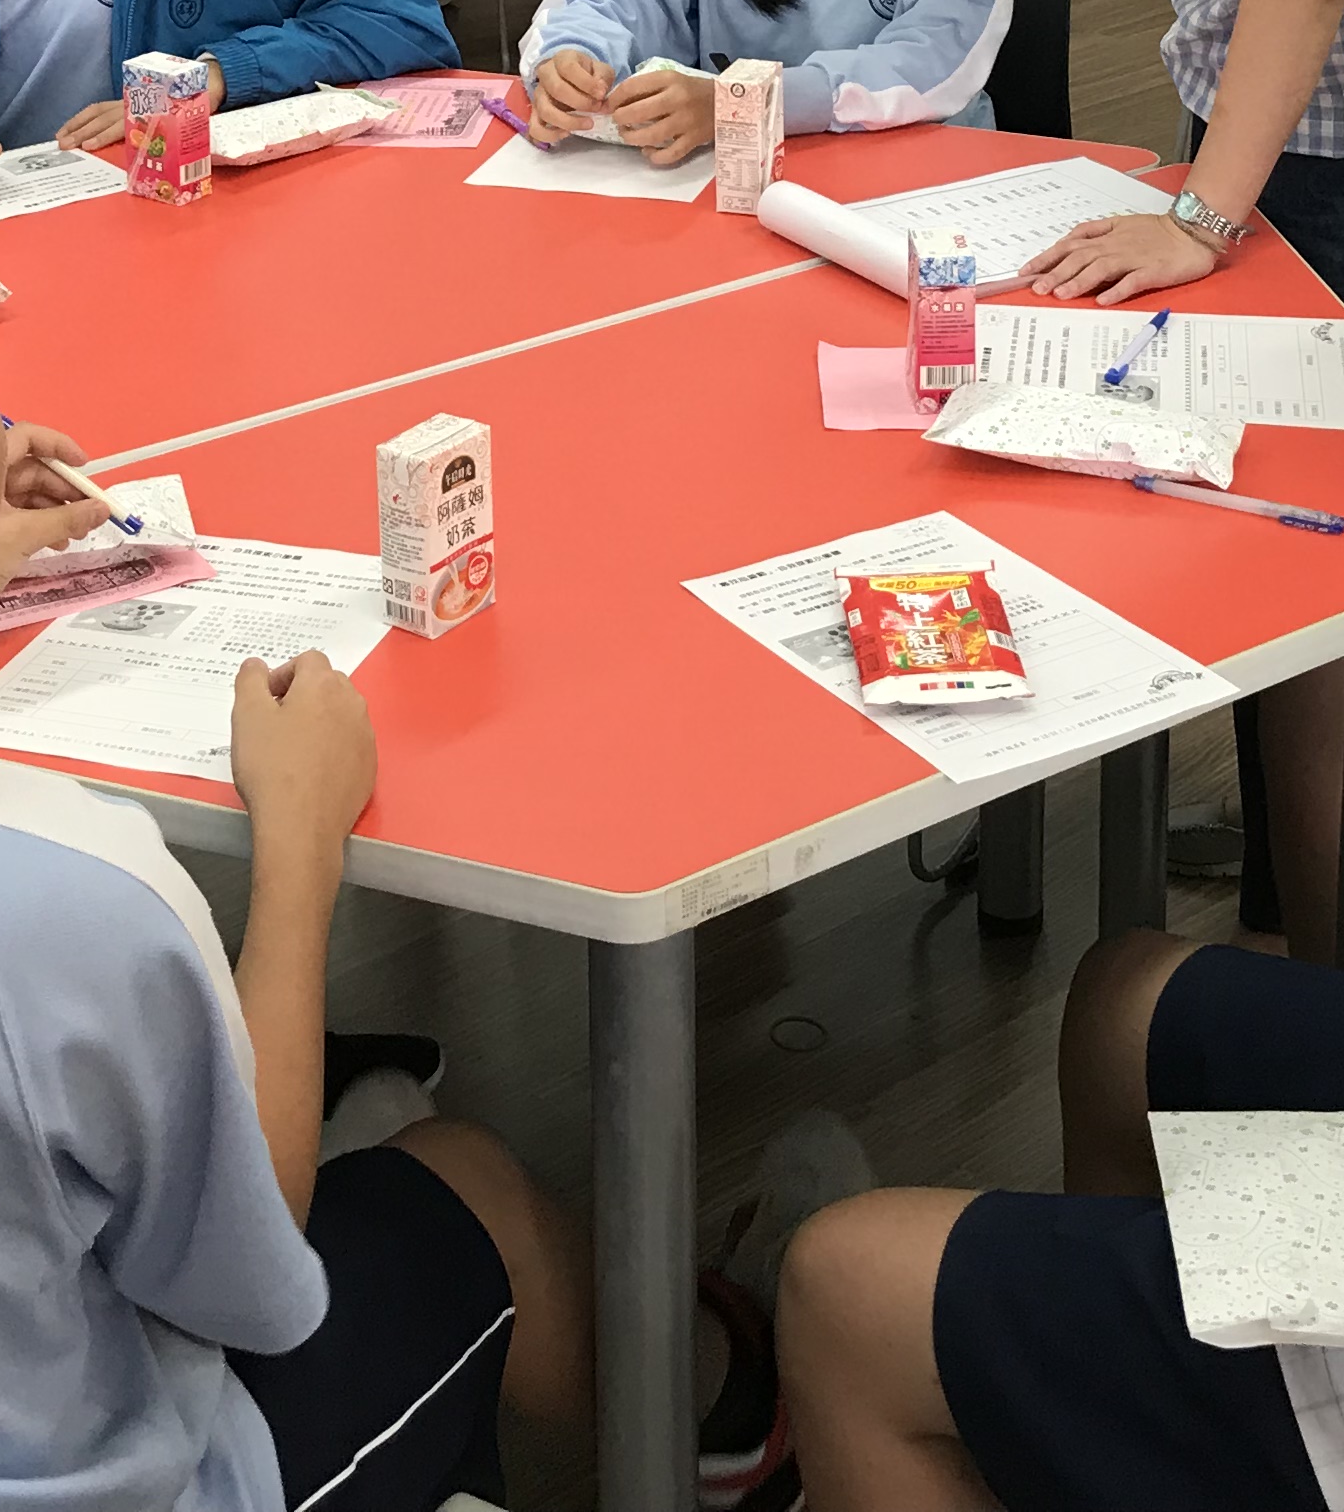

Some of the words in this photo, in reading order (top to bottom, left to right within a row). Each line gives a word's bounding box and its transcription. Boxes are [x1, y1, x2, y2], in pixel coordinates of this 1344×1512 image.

[437, 485, 484, 526] 阿薩姆
[446, 516, 476, 550] 奶茶
[896, 592, 949, 666] 特上紅茶
